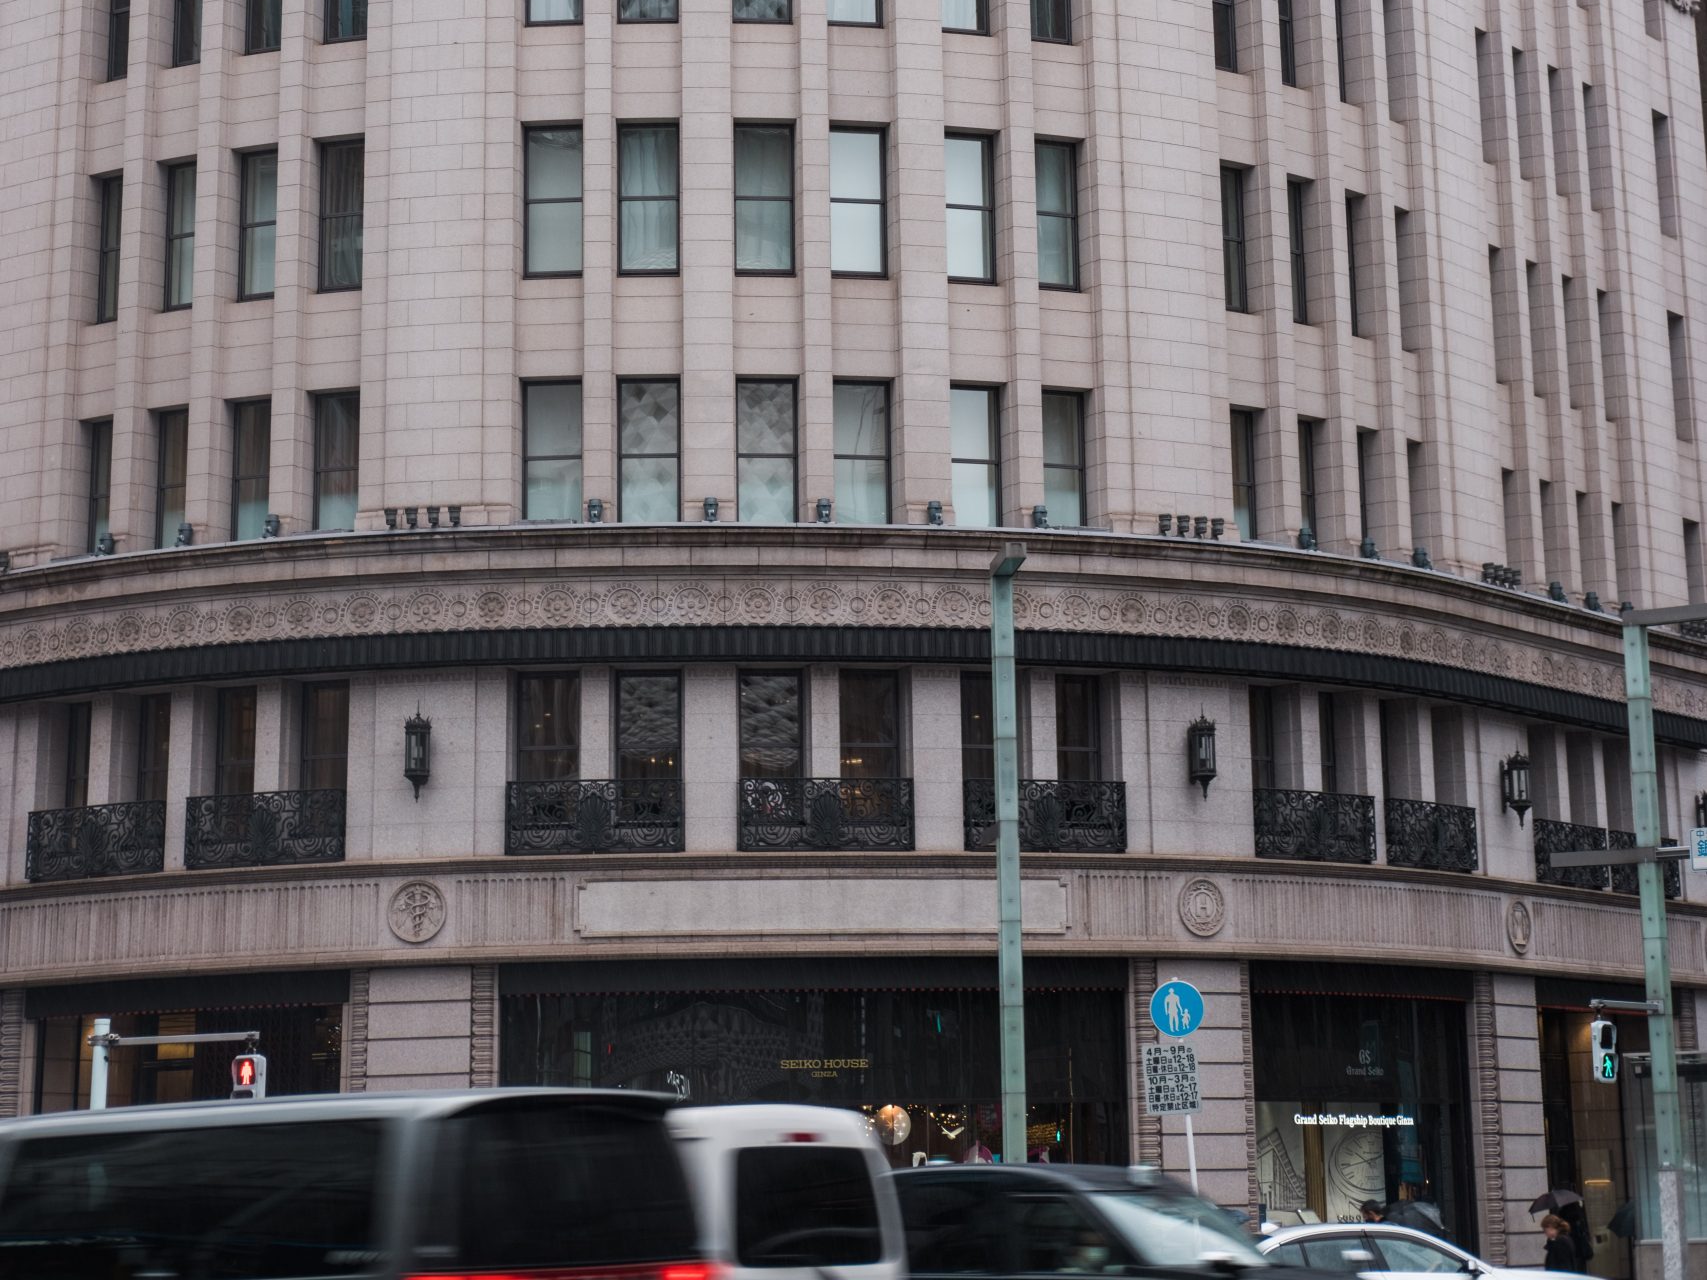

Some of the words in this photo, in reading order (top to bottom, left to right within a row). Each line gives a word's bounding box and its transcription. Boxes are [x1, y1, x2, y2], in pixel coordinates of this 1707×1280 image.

[780, 1060, 822, 1069] SEIKO
[824, 1058, 869, 1068] HOUSE
[1346, 1066, 1366, 1076] Grand
[1368, 1066, 1384, 1076] Seiko
[1294, 1114, 1317, 1125] Grand
[1318, 1114, 1338, 1125] Seiko
[1338, 1115, 1368, 1128] Flagship
[1368, 1116, 1396, 1128] Boutique
[1396, 1116, 1414, 1126] Ginza
